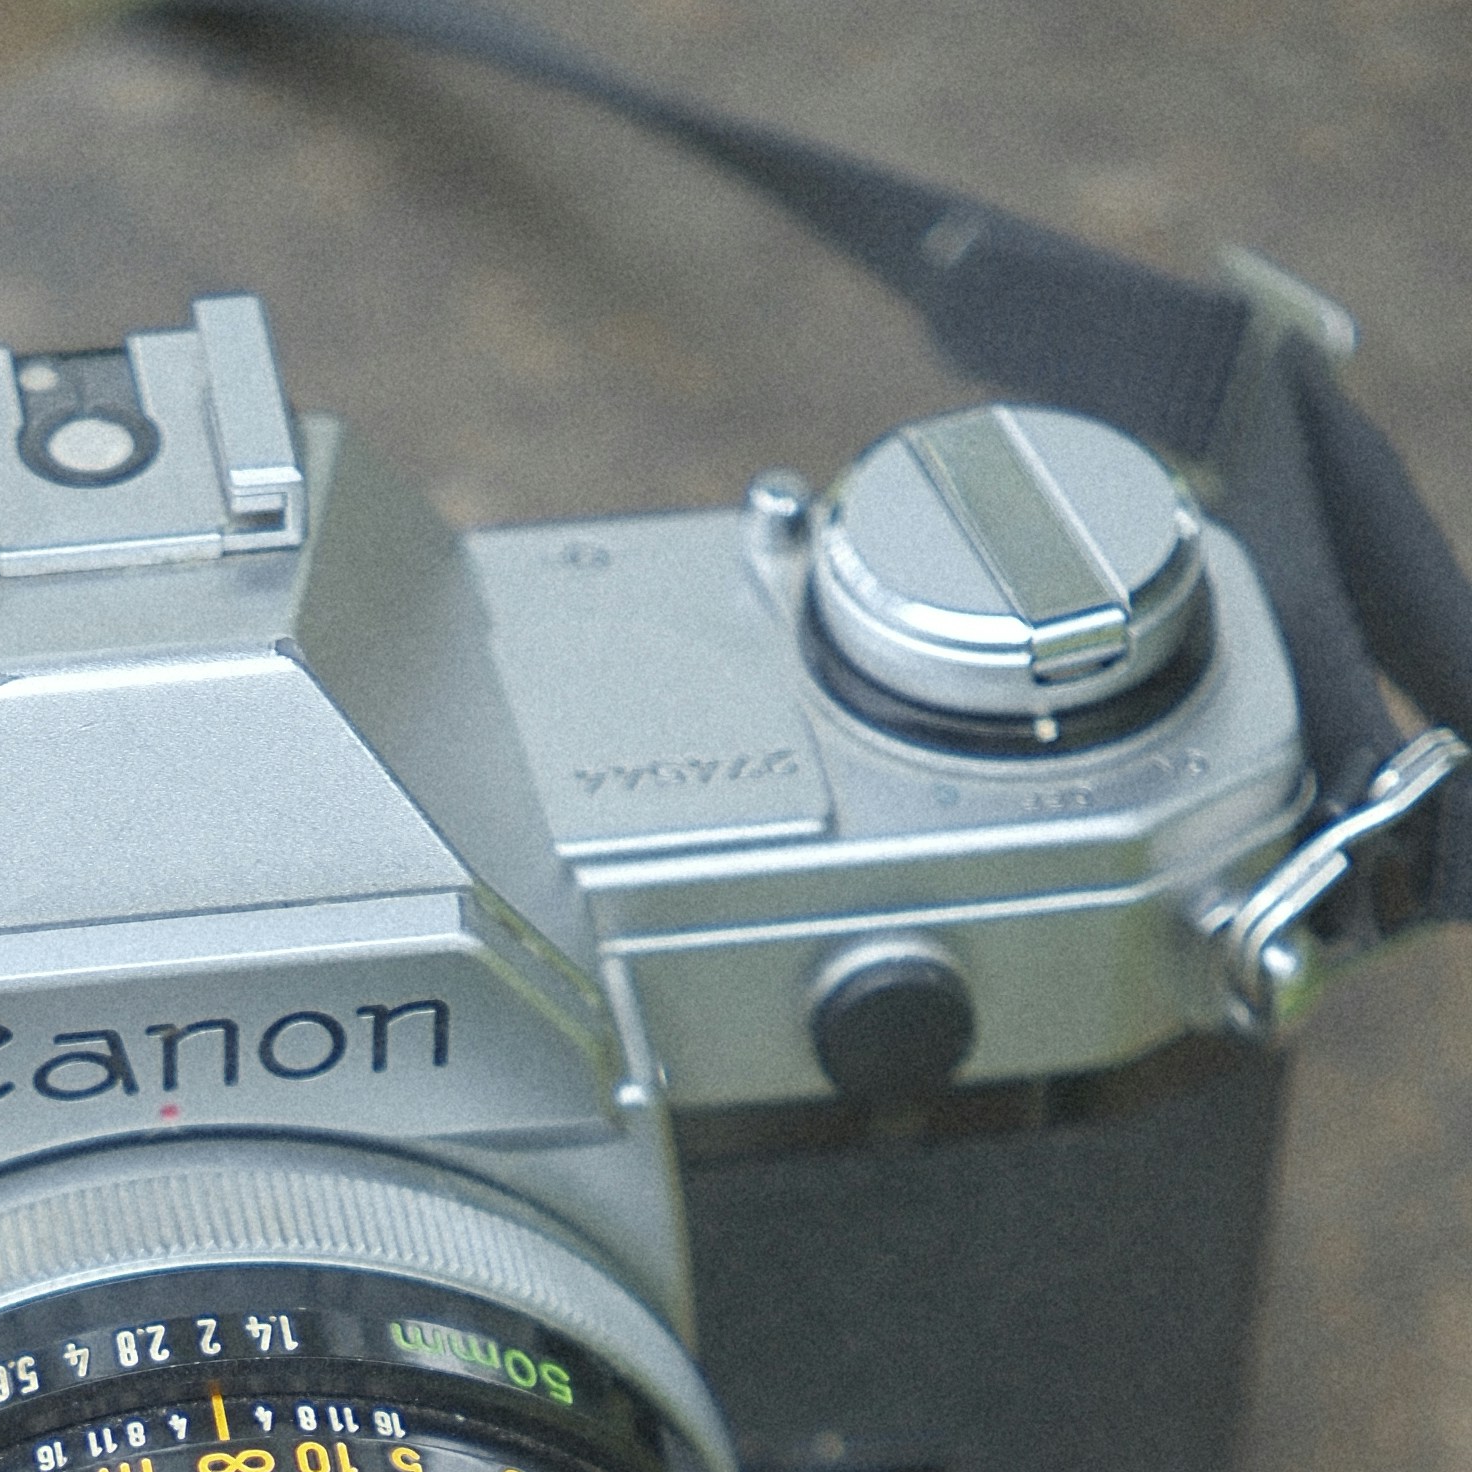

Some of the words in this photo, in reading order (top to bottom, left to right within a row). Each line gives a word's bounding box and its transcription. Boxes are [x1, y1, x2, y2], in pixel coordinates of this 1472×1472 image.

[115, 1324, 170, 1367] 2.8
[196, 1318, 221, 1355] 2
[245, 1315, 299, 1352] 1.4
[63, 1343, 90, 1377] 4
[391, 1322, 574, 1406] 50mm
[168, 1414, 188, 1440] 4
[254, 1405, 274, 1432] 4
[296, 1405, 318, 1432] 8
[327, 1405, 359, 1433] 11
[374, 1410, 406, 1438] 16
[87, 1428, 118, 1458] 11
[128, 1421, 146, 1447] 8
[36, 1442, 68, 1472] 16
